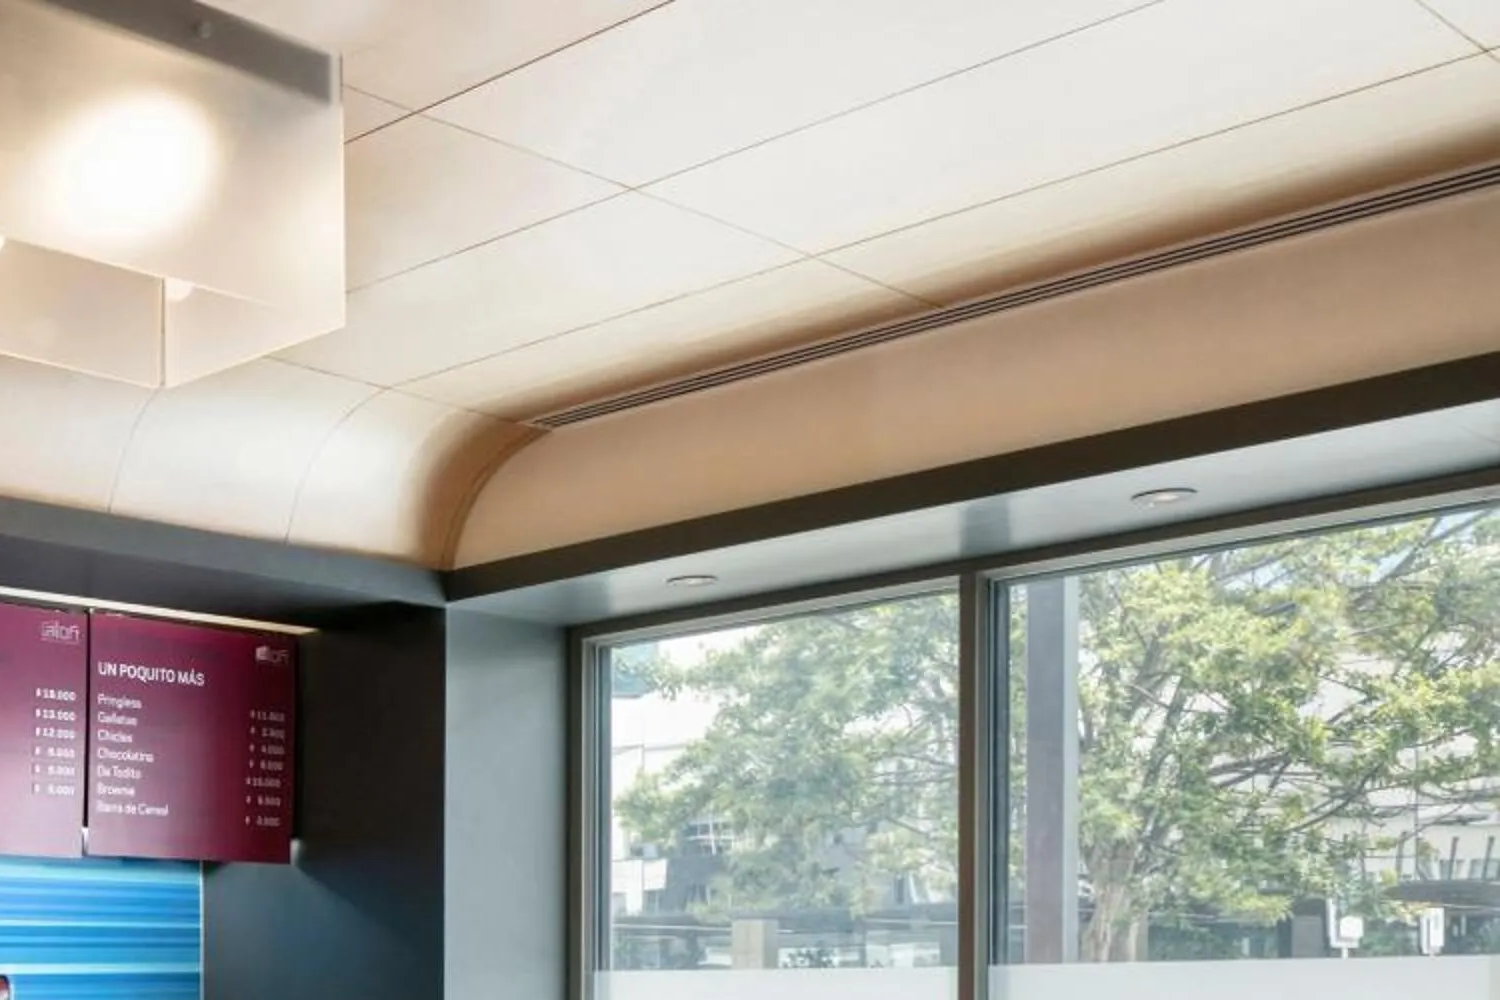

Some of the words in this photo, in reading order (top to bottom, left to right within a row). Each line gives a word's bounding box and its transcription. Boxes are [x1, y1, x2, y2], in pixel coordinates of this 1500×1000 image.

[97, 661, 117, 677] UN
[119, 663, 175, 684] POQUITO
[178, 668, 205, 687] MÁS
